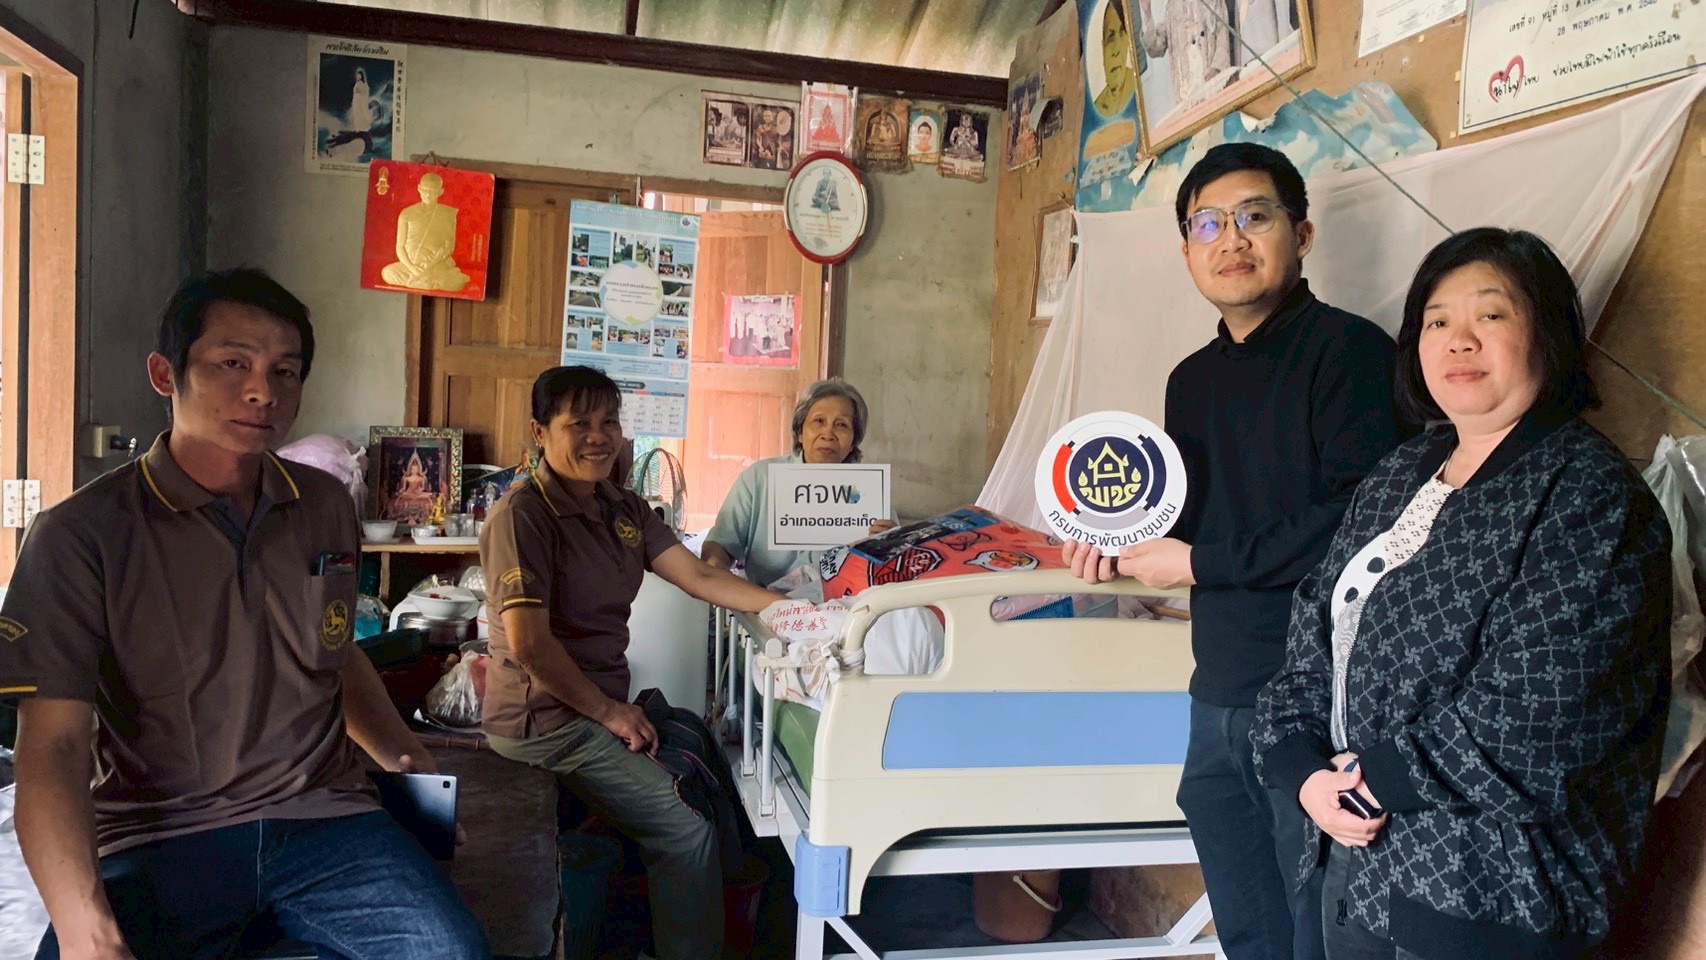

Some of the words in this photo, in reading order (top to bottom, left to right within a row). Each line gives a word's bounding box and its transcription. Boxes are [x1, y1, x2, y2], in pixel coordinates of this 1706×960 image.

[1048, 501, 1177, 546] กรมการพัฒนาชุมชน
